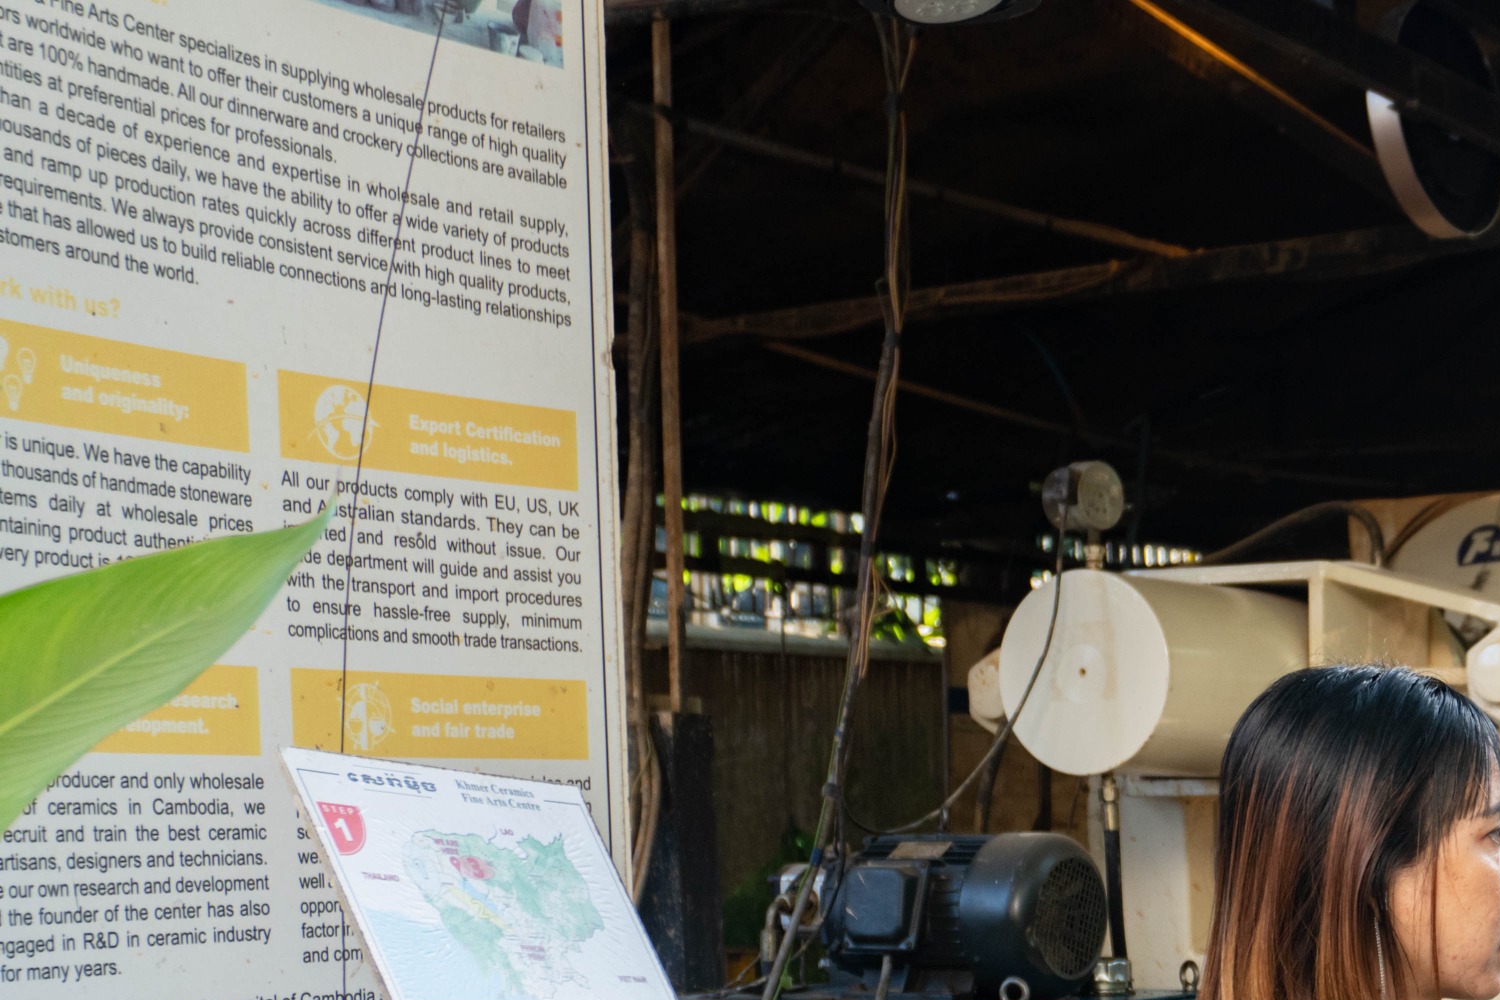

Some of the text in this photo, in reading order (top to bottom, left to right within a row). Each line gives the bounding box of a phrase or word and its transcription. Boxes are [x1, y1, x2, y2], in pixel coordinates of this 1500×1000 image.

[123, 13, 565, 143] Center specializes supplying retailers
[25, 14, 566, 170] worldwide customers quality
[68, 82, 336, 163] preferential professionals.
[88, 56, 567, 189] handmade. dinnerware crockery available
[56, 103, 568, 238] decade experience expertise supply,
[115, 175, 474, 264] production quickly product
[291, 189, 569, 258] ability variety products
[65, 244, 198, 285] around world.
[142, 206, 570, 306] always provide consistent quality products,
[76, 218, 571, 328] allowed reliable connections long-lasting relationships
[60, 354, 161, 387] Uniqueness
[62, 385, 189, 421] and originality:
[409, 414, 560, 447] Export Certification
[22, 437, 251, 486] unique. capability
[410, 441, 513, 465] and logistics.
[1, 459, 252, 507] thousands handmade stoneware
[404, 488, 454, 509] comply
[122, 503, 254, 533] wholesale prices
[401, 508, 480, 531] standards.
[447, 537, 545, 559] without issue.
[455, 584, 582, 607] import procedures
[374, 602, 582, 630] hassle-free supply, minimum
[412, 631, 582, 652] smooth transactions.
[411, 697, 541, 719] Social enterprise
[412, 722, 515, 739] and fair trade
[190, 773, 264, 790] wholesale
[455, 779, 535, 799] Khmer Ceramics
[48, 798, 233, 817] ceramics Cambodia,
[322, 804, 354, 816] STEP
[462, 793, 542, 812] Fine Arts Centre
[208, 824, 267, 841] ceramic
[334, 818, 353, 841] 1
[66, 849, 267, 873] designers technicians.
[466, 857, 485, 879] 3
[75, 875, 269, 897] research development
[361, 871, 400, 883] THAILAND
[39, 903, 202, 925] founder center
[147, 925, 271, 947] ceramic industry
[74, 962, 121, 982] years.
